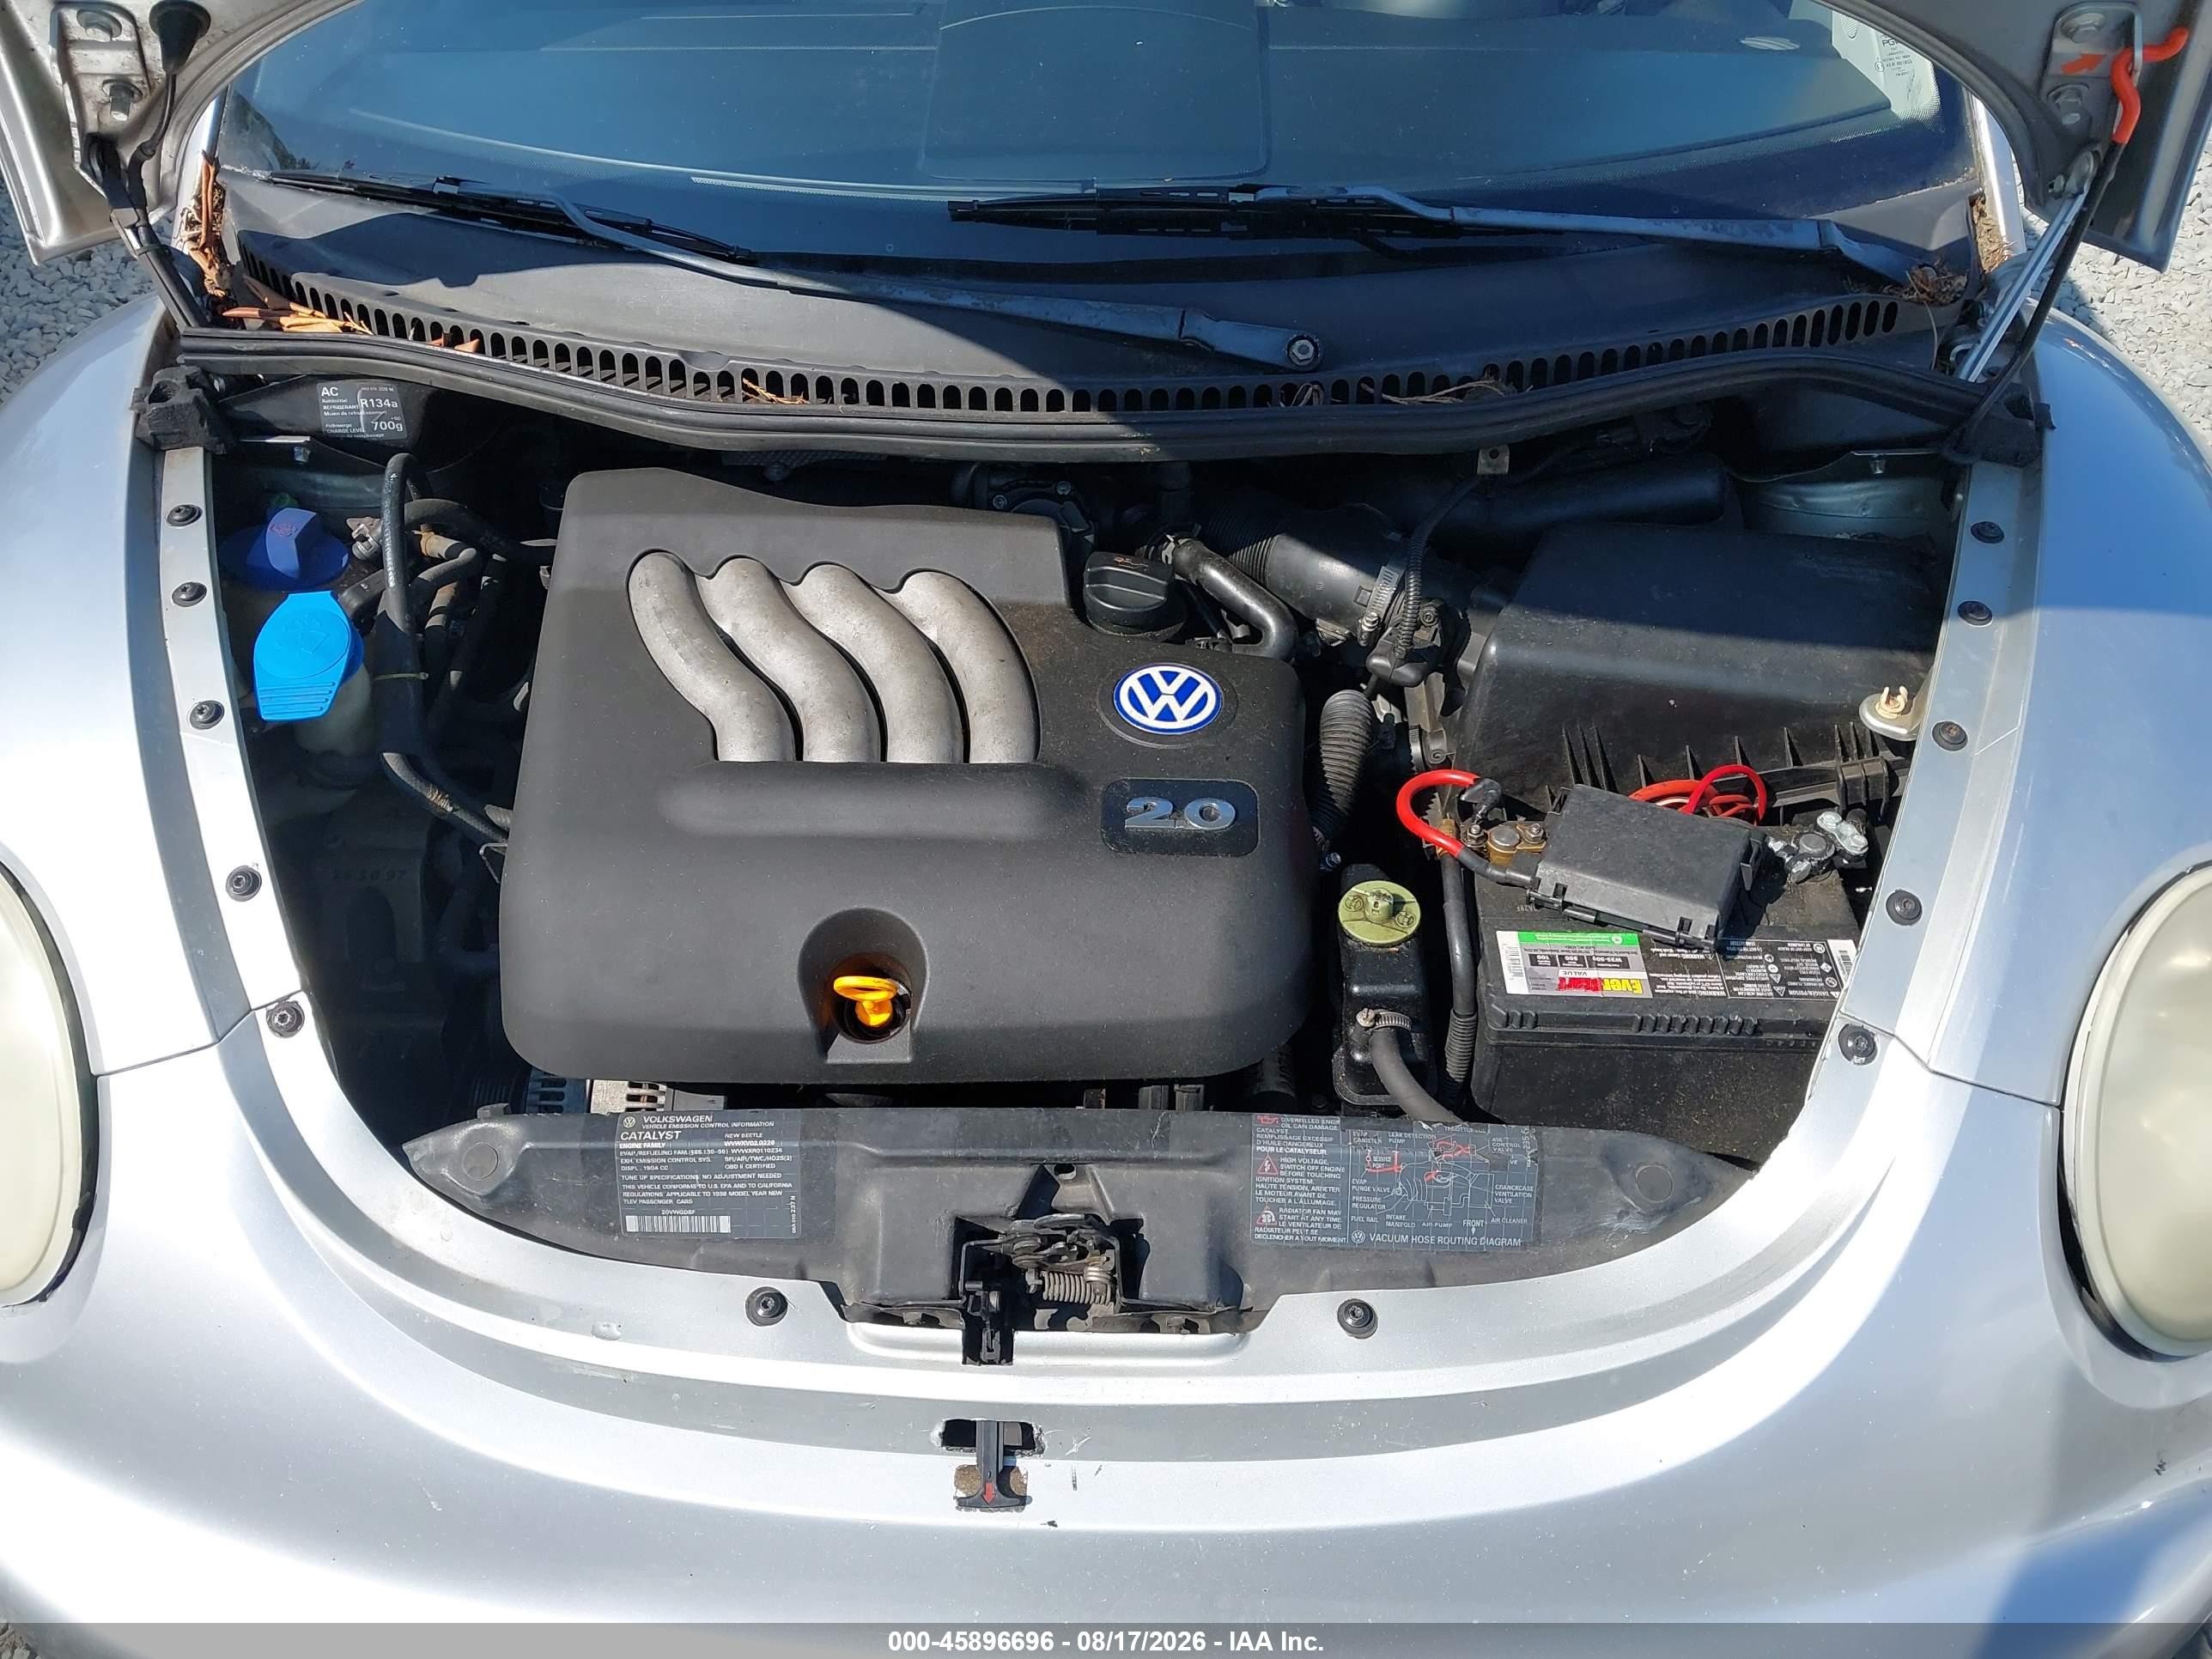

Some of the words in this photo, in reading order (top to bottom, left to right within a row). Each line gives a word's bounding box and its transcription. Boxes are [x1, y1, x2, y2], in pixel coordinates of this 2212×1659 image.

[321, 387, 338, 397] AC
[361, 398, 398, 408] R134a
[371, 421, 404, 432] 700g
[1125, 797, 1236, 831] 2.0
[621, 1130, 682, 1140] CATALYST
[1370, 1233, 1409, 1243] VACUUM
[1412, 1235, 1436, 1244] HOSE
[1437, 1236, 1478, 1245] ROUTING
[1480, 1237, 1522, 1247] DIAGRAM
